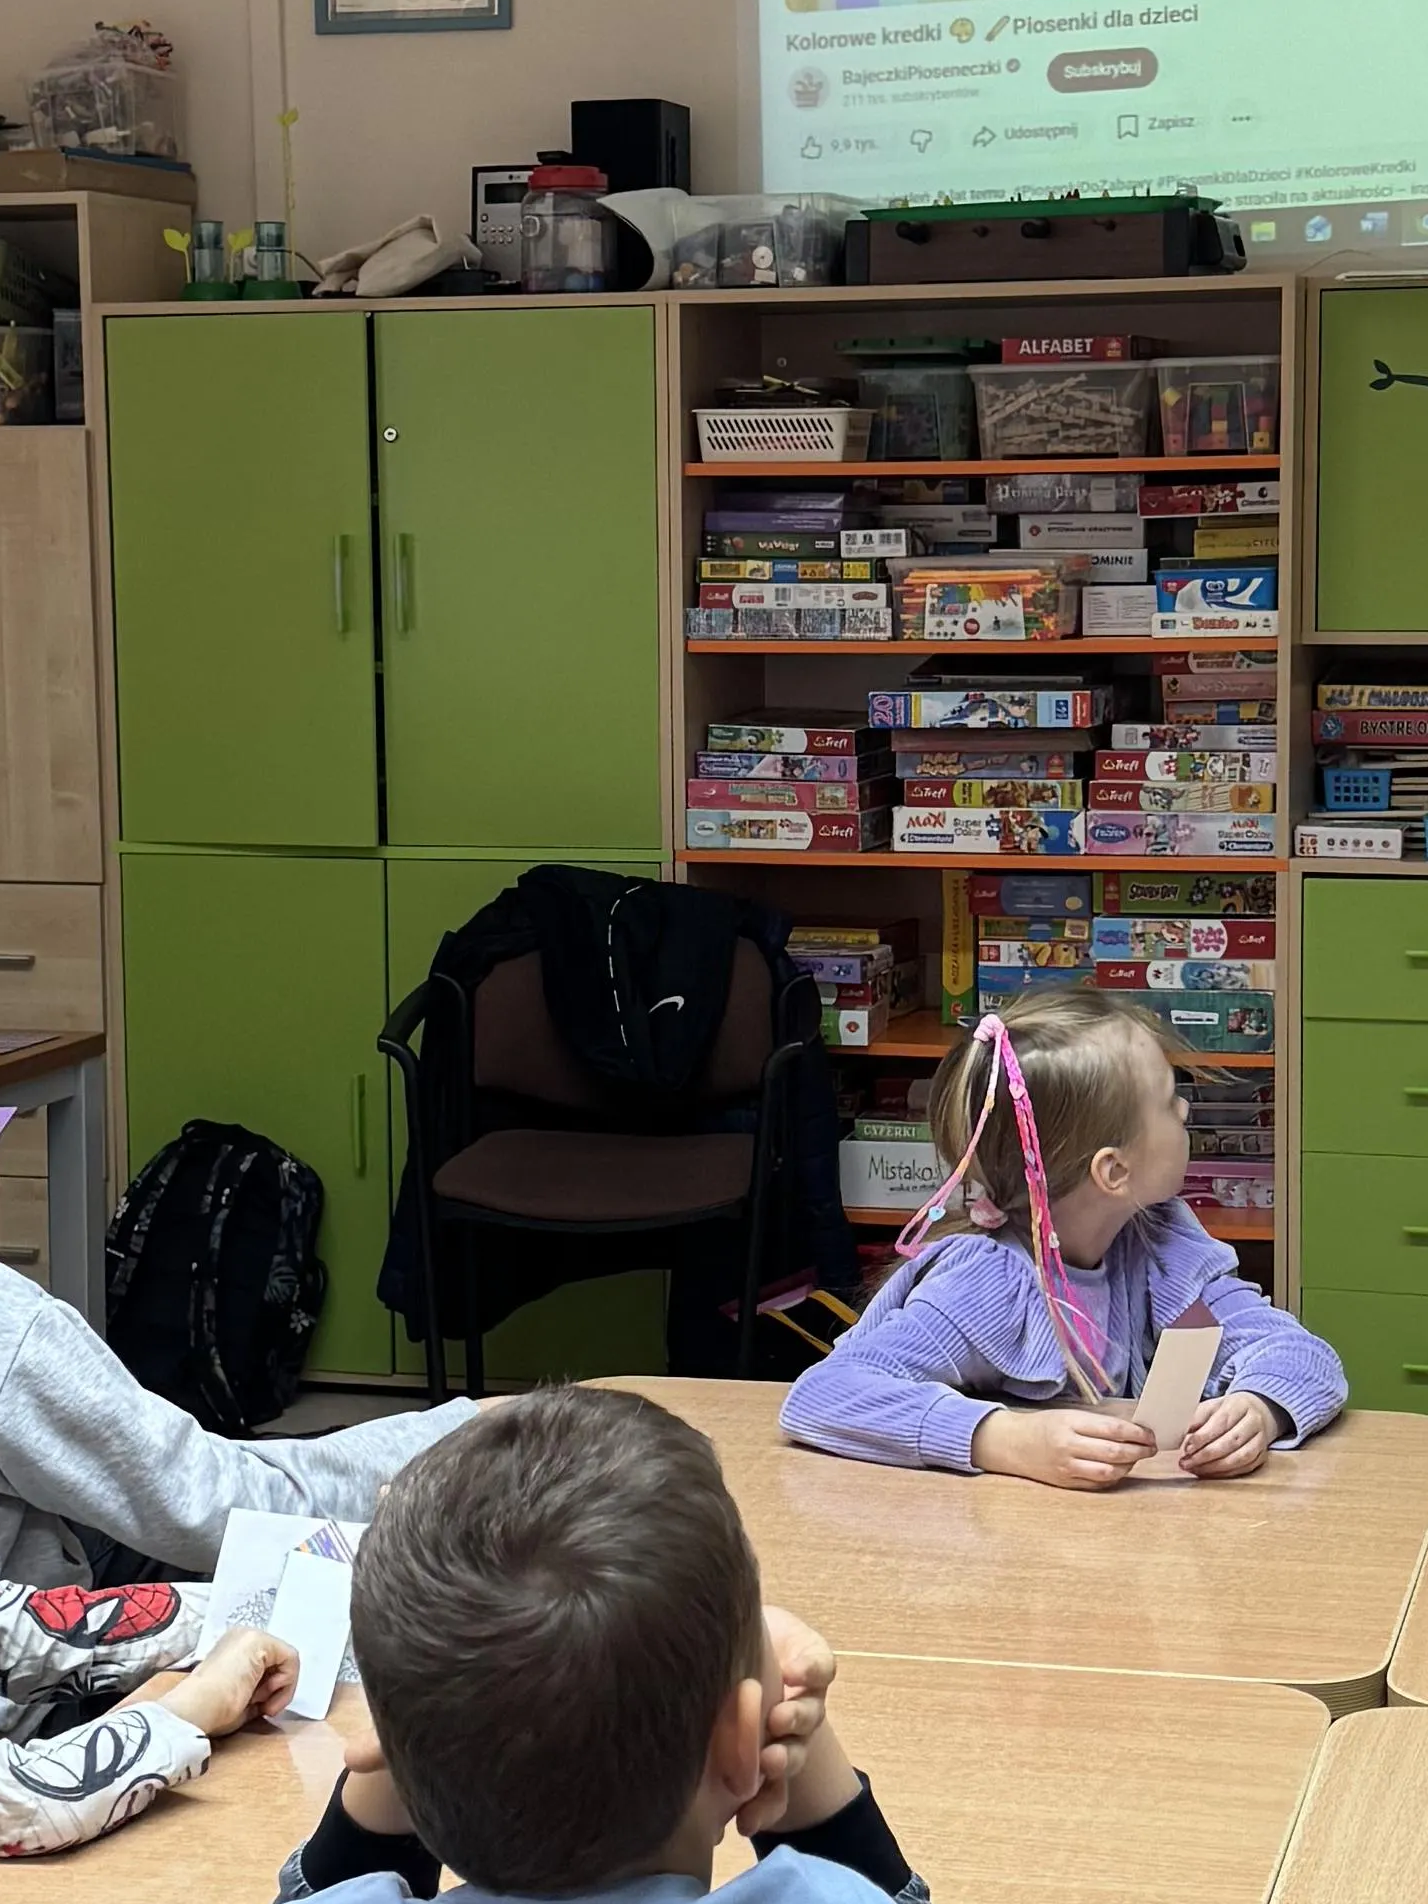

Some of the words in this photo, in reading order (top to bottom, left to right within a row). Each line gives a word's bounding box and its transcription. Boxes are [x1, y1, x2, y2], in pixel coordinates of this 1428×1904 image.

[786, 30, 877, 52] Kolorowe
[882, 23, 943, 46] kredki
[1013, 12, 1099, 35] Piosenki
[1104, 8, 1134, 29] dla
[1139, 4, 1201, 26] dzieci
[842, 60, 1002, 87] BajeczkiPioseneczki
[1063, 58, 1142, 82] Subskrybuj
[1004, 122, 1080, 143] Udostępnij
[1148, 113, 1196, 133] Zapisz
[1291, 190, 1308, 205] na
[1312, 183, 1394, 203] aktualności
[1019, 338, 1094, 354] ALFABET
[1359, 719, 1414, 736] BYSTRE
[825, 736, 849, 749] Trefl
[1115, 759, 1140, 772] Trefl
[922, 786, 948, 798] Trefl
[1109, 789, 1133, 802] Trefl
[953, 817, 982, 830] Super
[830, 825, 854, 837] Trefl
[954, 827, 983, 838] Color
[863, 1124, 916, 1137] CYFERKI
